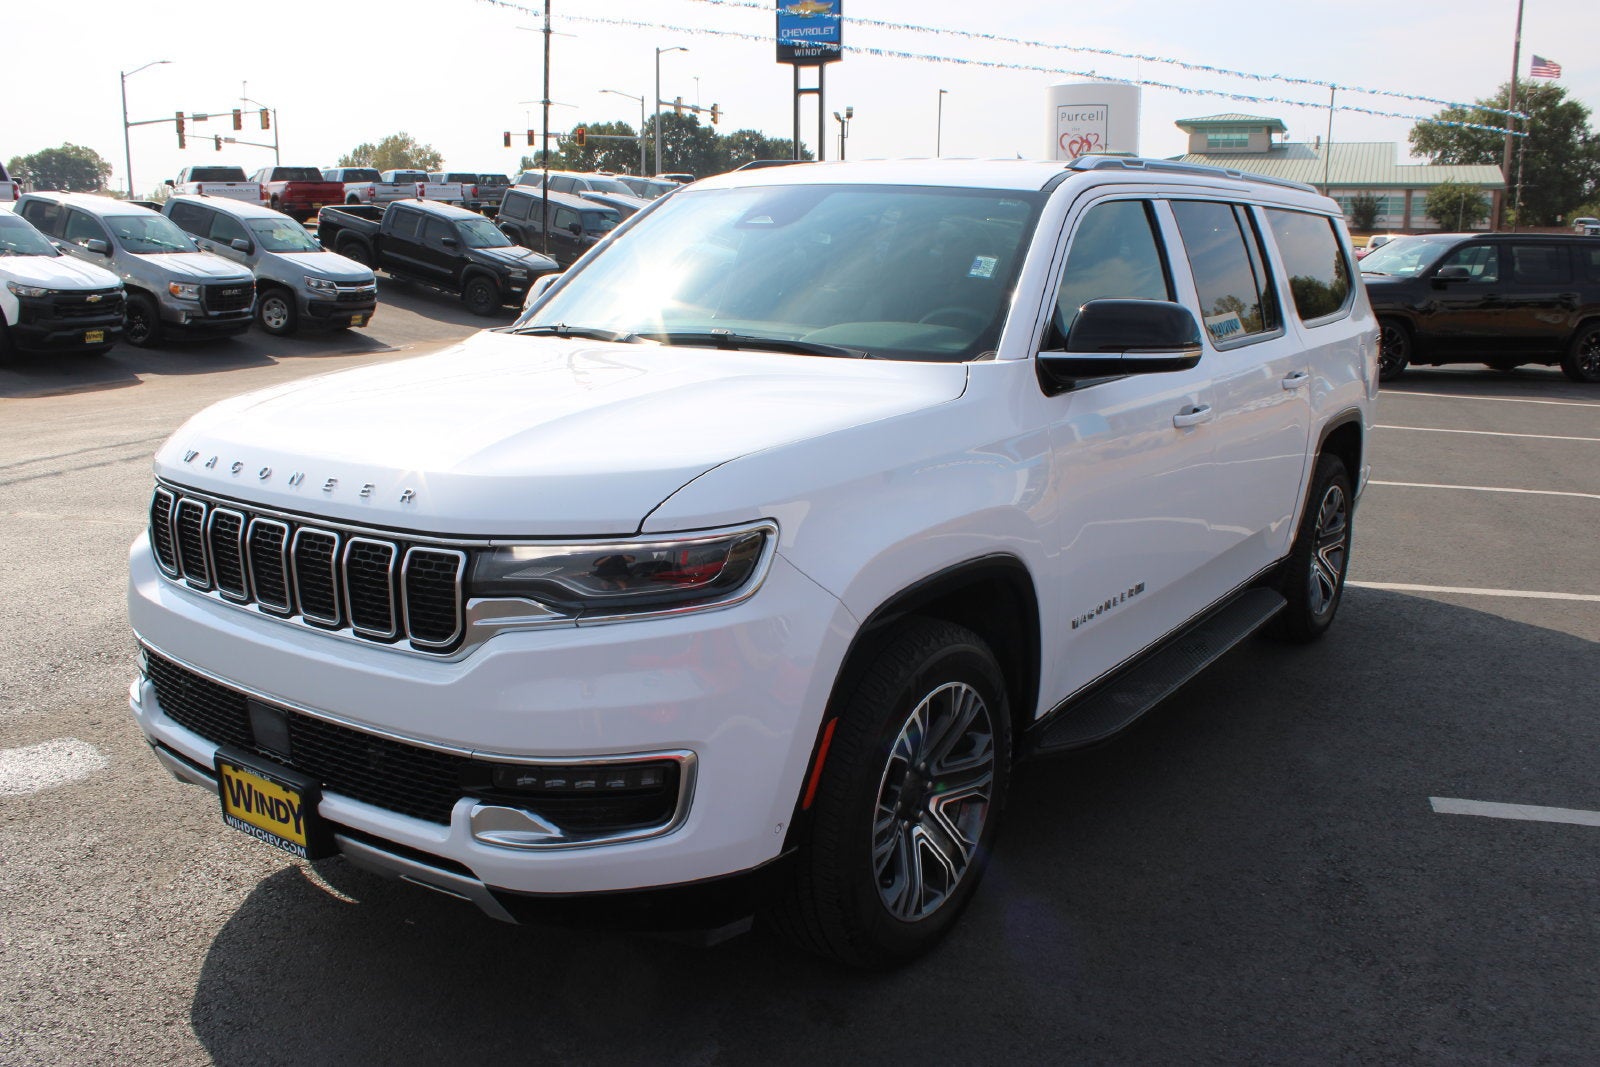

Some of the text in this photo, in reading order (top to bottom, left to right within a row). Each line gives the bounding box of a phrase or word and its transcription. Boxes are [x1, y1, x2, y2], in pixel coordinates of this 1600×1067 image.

[781, 26, 835, 38] CHEVROLET
[794, 48, 822, 57] WINDY
[1060, 110, 1104, 121] Purcell
[184, 449, 417, 504] WAGONEER
[1071, 588, 1135, 630] WAGONEER
[224, 774, 303, 835] WINDY
[226, 814, 307, 859] WINDYCHEV.COM
